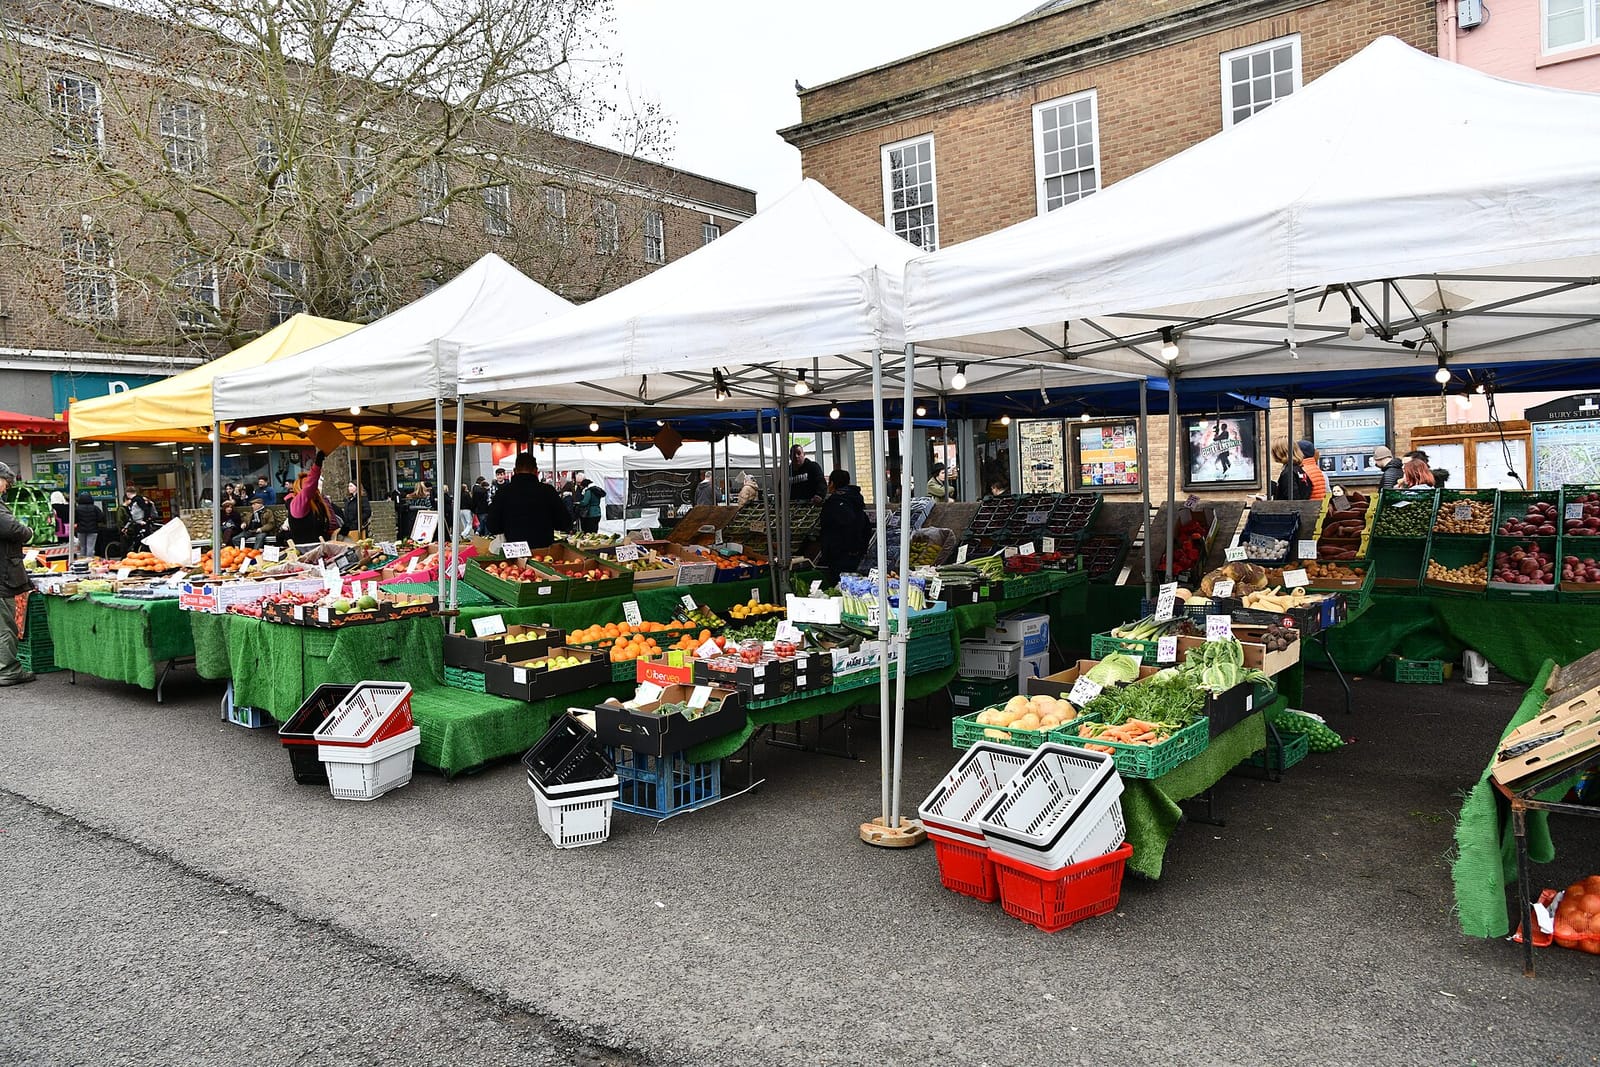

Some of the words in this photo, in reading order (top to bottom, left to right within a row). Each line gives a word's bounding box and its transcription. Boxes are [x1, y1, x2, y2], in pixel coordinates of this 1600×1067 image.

[1549, 411, 1571, 419] BURY
[1573, 410, 1583, 418] ST
[1318, 418, 1380, 430] CHILDREN
[652, 670, 679, 682] iberveg
